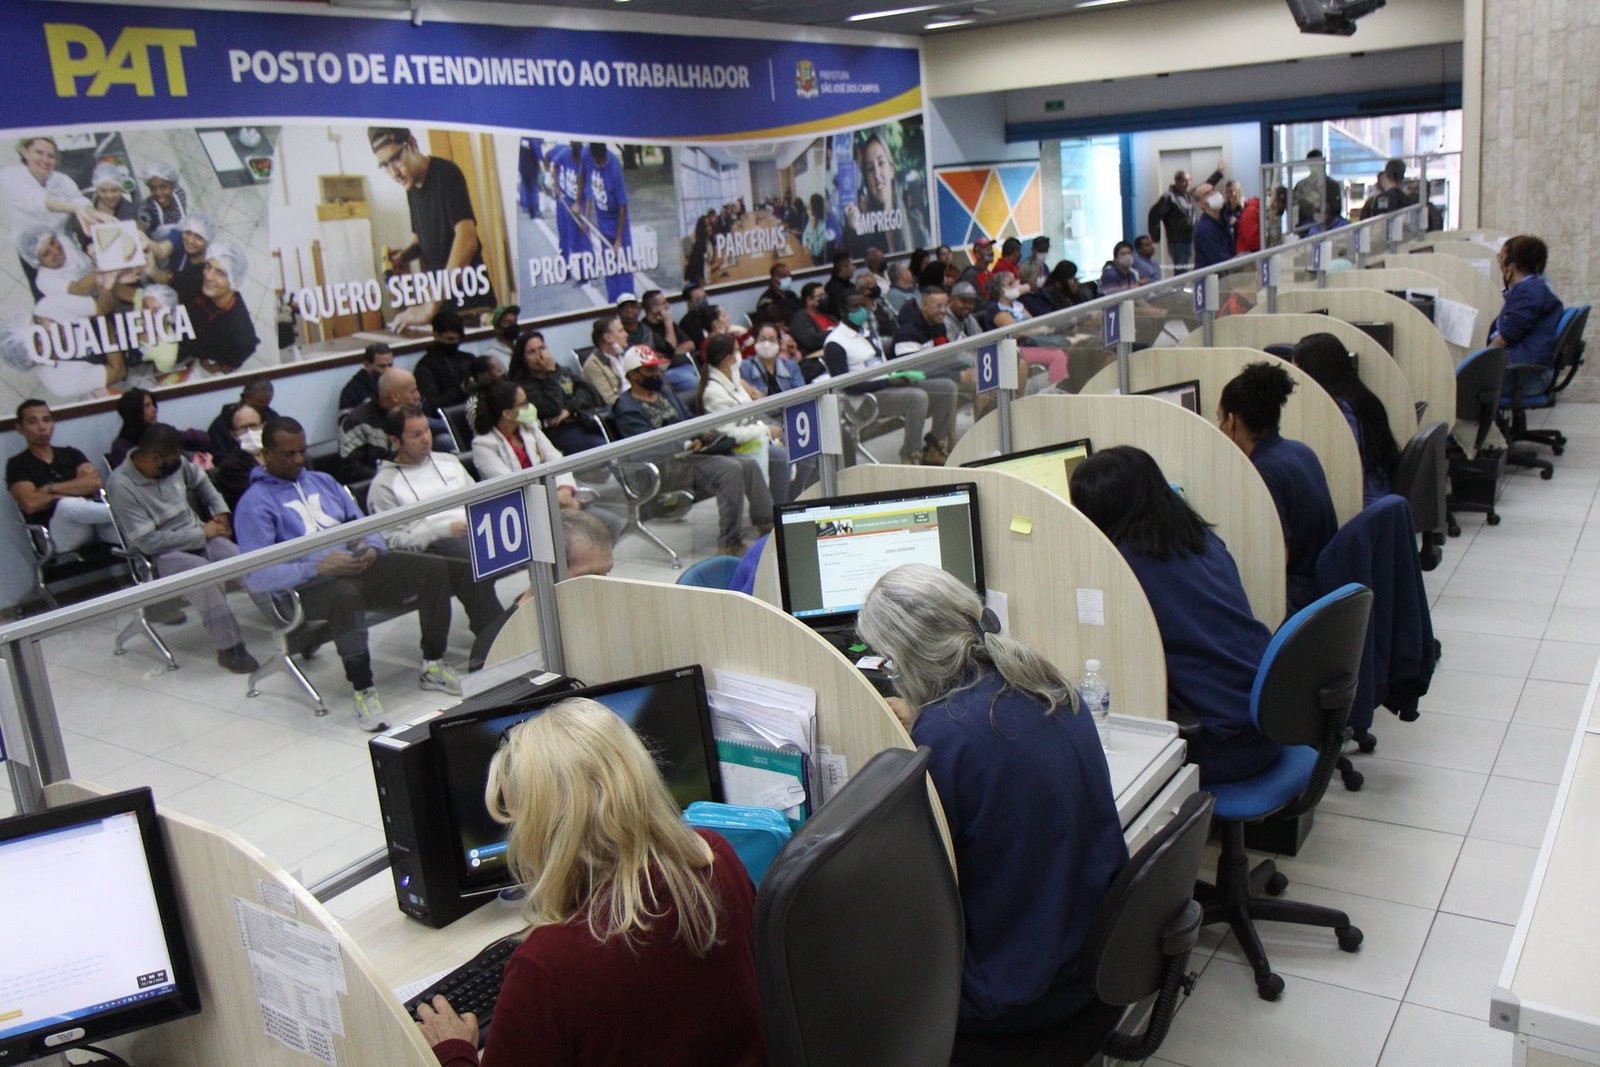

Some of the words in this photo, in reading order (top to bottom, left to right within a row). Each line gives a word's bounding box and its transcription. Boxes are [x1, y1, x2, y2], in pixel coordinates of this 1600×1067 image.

[43, 22, 197, 97] PAT
[228, 49, 343, 84] POSTO
[347, 51, 388, 85] DE
[392, 53, 575, 88] ATENDIMENTO
[579, 60, 611, 88] AO
[612, 61, 750, 90] TRABALHADOR
[715, 224, 787, 259] PARCERIAS
[300, 279, 383, 324] QUERO
[387, 264, 490, 309] SERVIÇOS
[1196, 285, 1203, 306] 6
[26, 303, 197, 366] QUALIFICA
[1108, 312, 1117, 337] 7
[982, 352, 993, 384] 8
[795, 410, 811, 448] 9
[476, 505, 522, 560] 10
